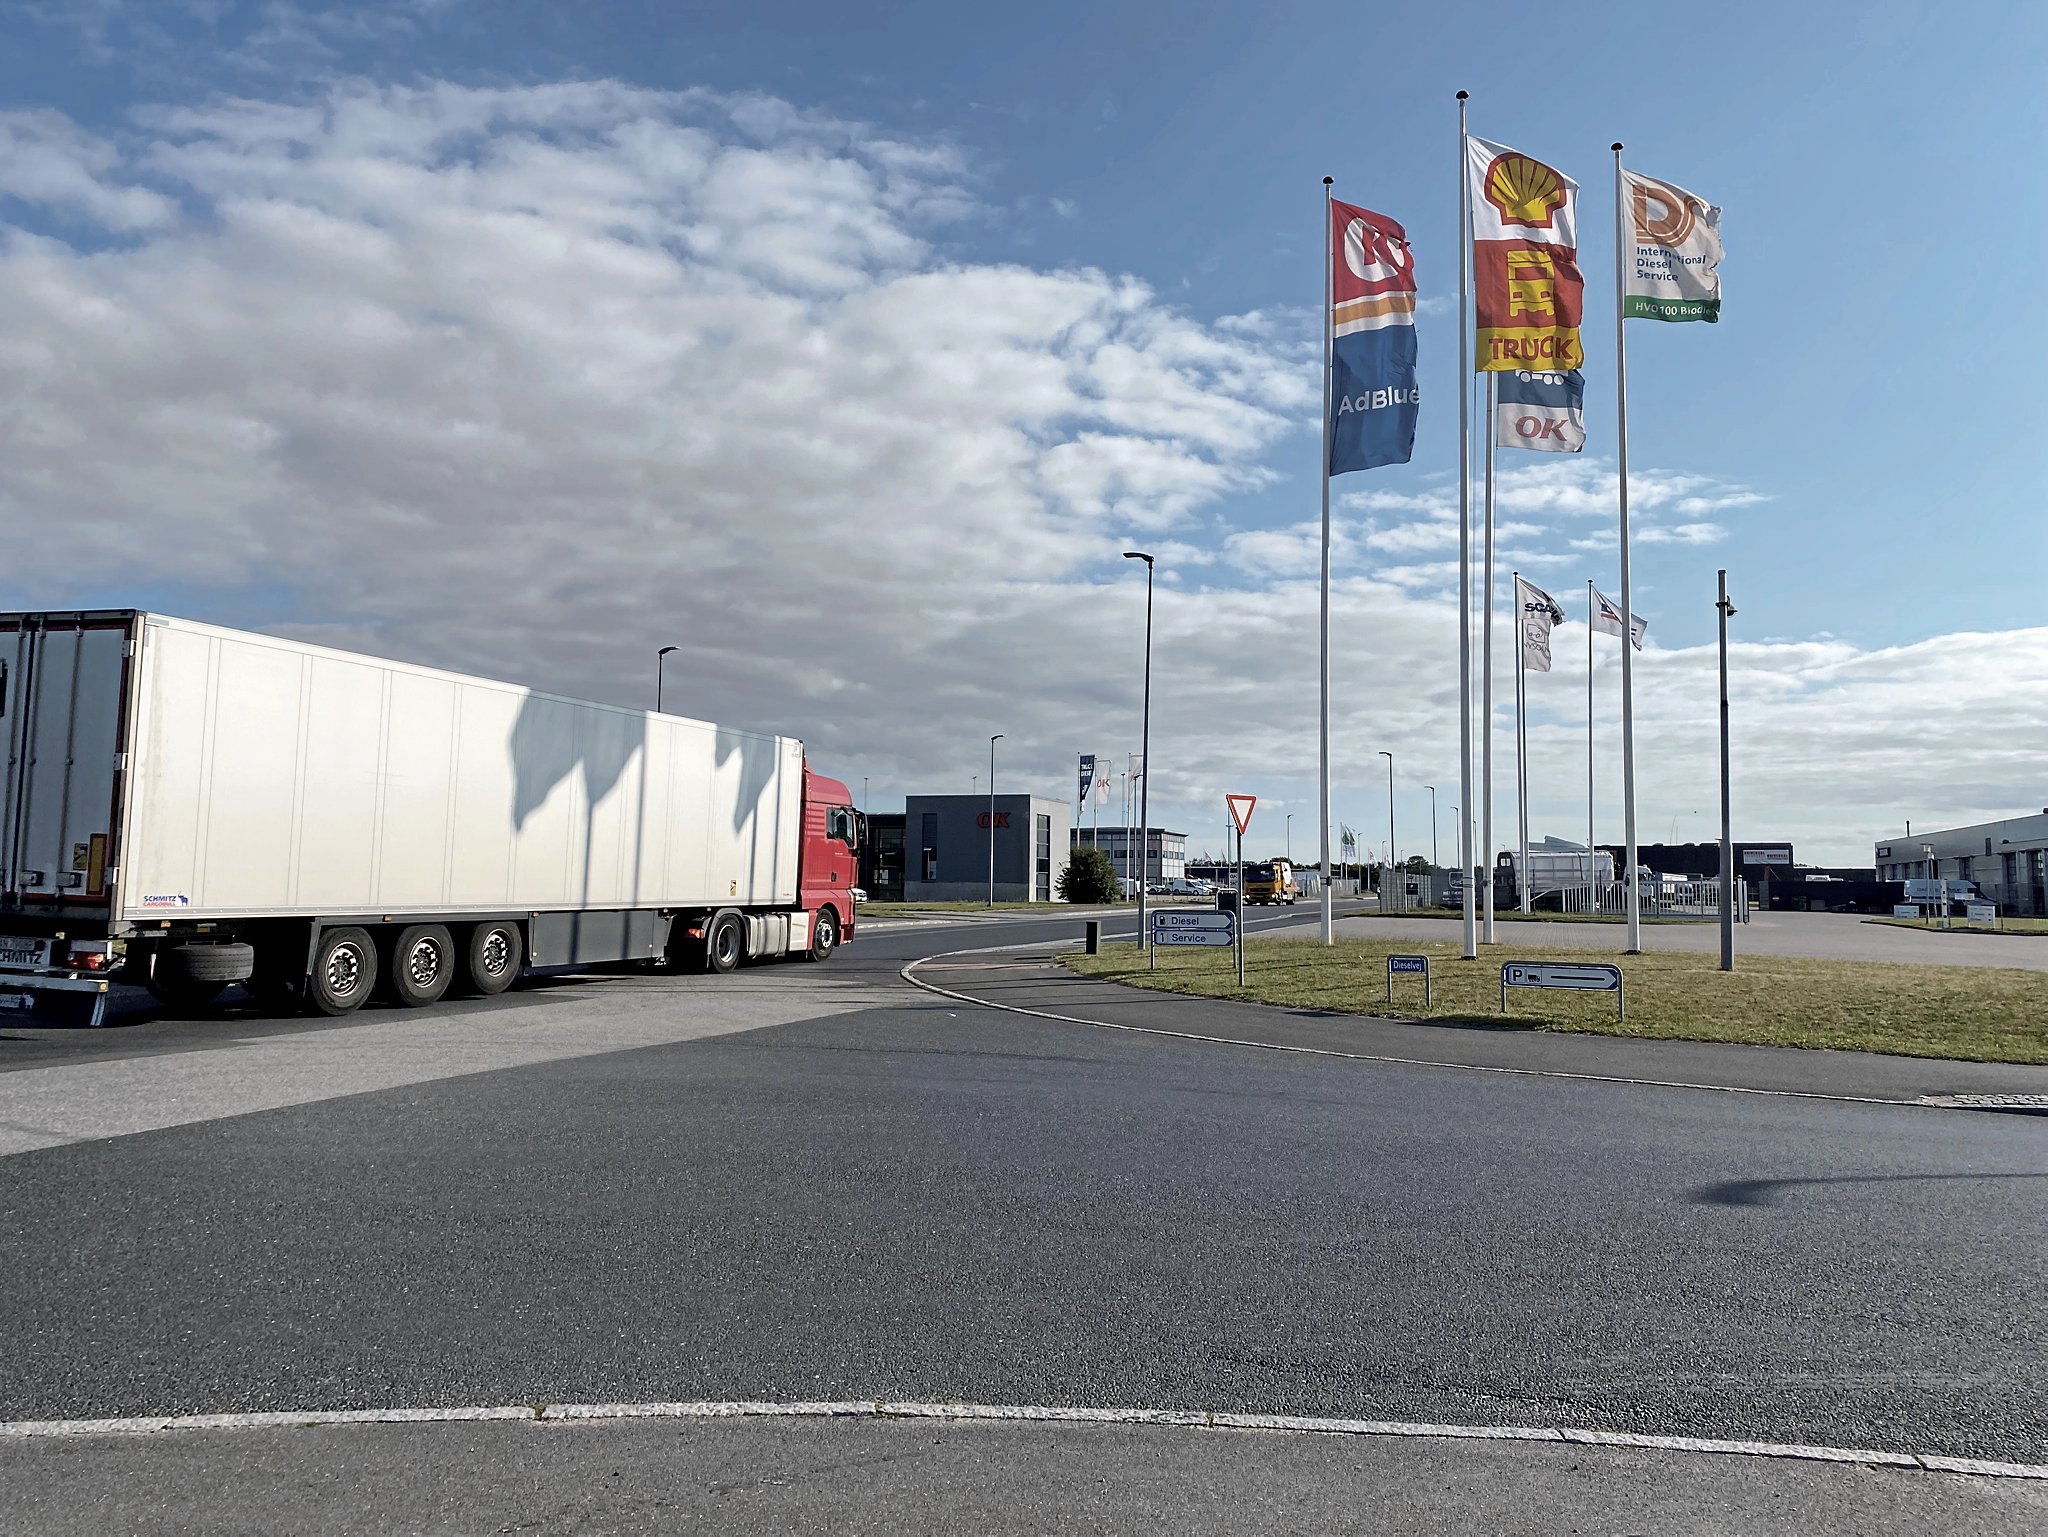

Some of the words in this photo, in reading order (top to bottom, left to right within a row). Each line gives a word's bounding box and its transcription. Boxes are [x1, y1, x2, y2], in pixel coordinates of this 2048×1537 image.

[1637, 258, 1672, 269] Diesel
[1637, 269, 1679, 281] Service
[1488, 335, 1574, 361] TRUCK
[1338, 385, 1420, 416] AdBlue
[1515, 415, 1569, 442] OK
[1096, 778, 1110, 788] OK
[976, 811, 1011, 828] OK
[1171, 916, 1199, 926] Diesel
[1171, 933, 1206, 943] Service
[0, 951, 43, 964] HMITZ
[1393, 960, 1422, 972] Dieselvej
[1512, 969, 1523, 982] P
